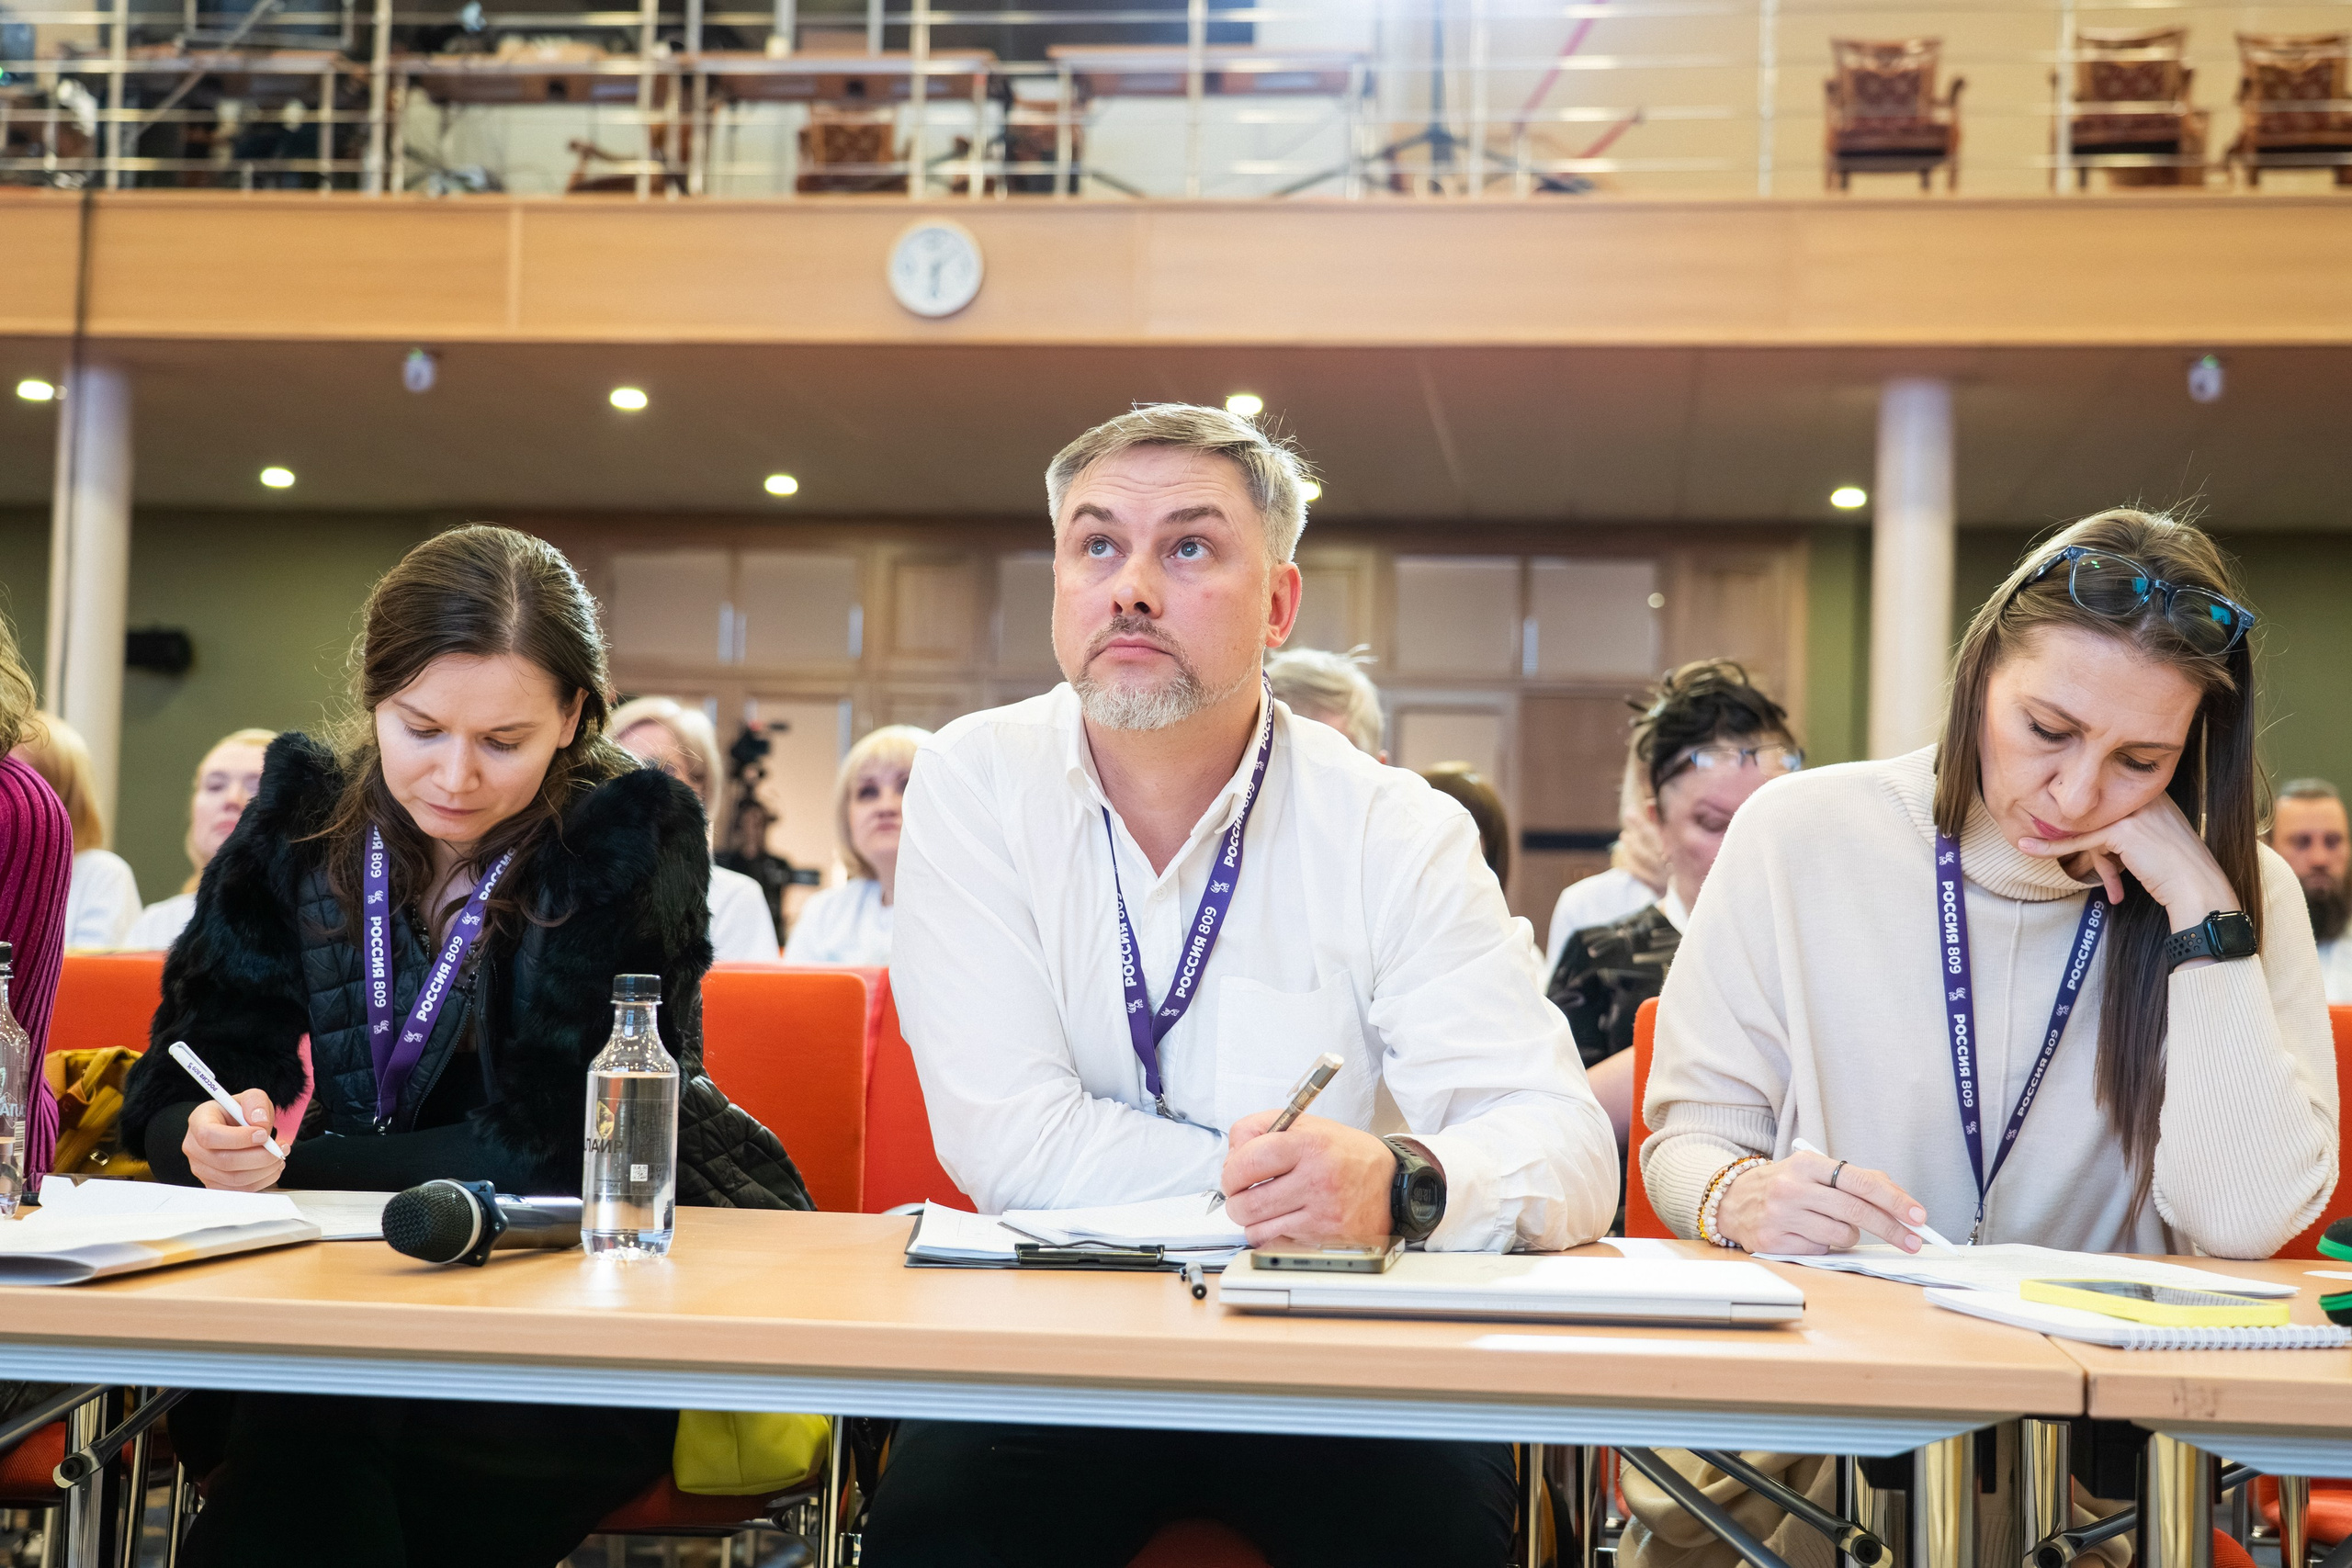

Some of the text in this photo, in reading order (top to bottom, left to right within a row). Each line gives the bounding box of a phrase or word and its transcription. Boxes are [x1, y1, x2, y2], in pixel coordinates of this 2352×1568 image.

[370, 852, 383, 878] 809
[370, 916, 387, 1008] РОССИЯ 809
[1175, 906, 1217, 998] РОССИЯ 809
[1942, 881, 1962, 975] РОССИЯ 809
[2066, 900, 2105, 990] РОССИЯ 809
[415, 935, 463, 1022] РОССИЯ 809
[199, 1074, 218, 1091] РОССИЯ
[1953, 1013, 1973, 1108] РОССИЯ 809
[2017, 1029, 2058, 1117] РОССИЯ 809
